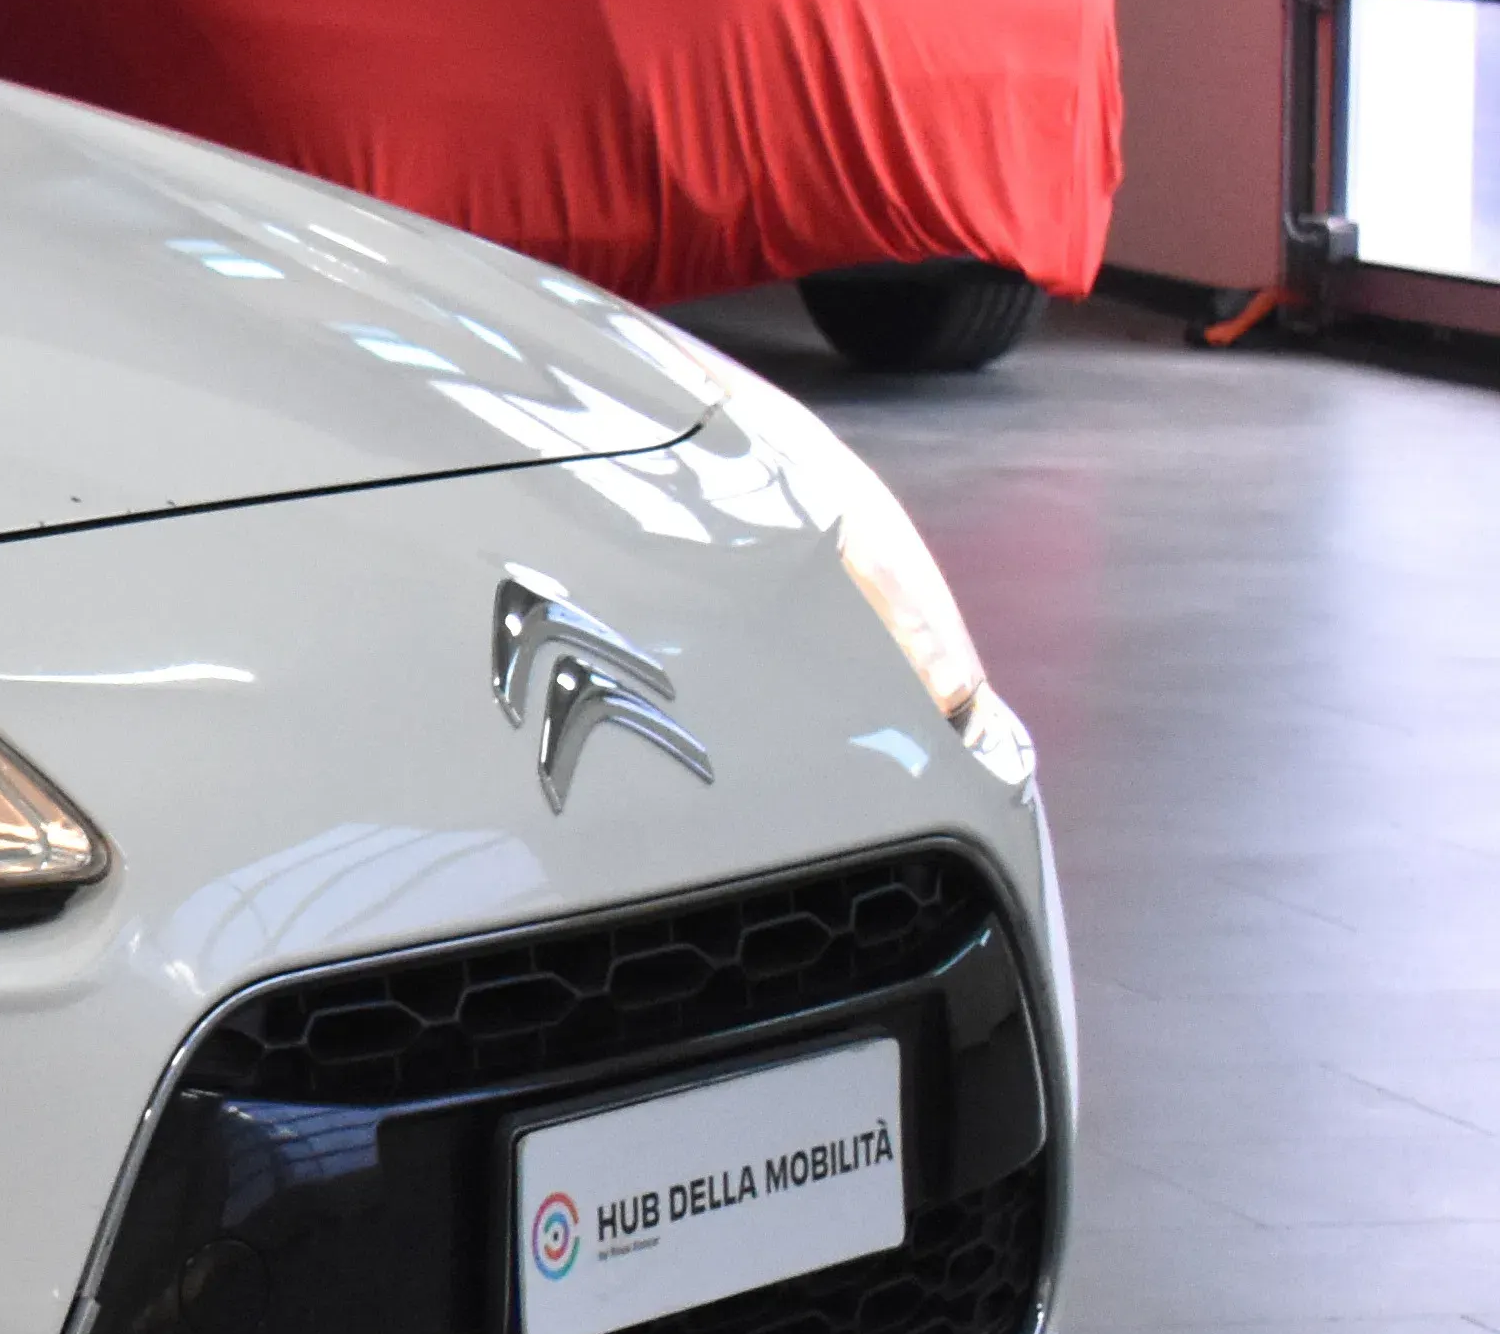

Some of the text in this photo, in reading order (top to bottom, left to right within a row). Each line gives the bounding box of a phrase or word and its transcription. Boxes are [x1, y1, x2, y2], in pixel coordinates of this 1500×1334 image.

[597, 1117, 894, 1242] HUB DELLA MOBILITÀ
